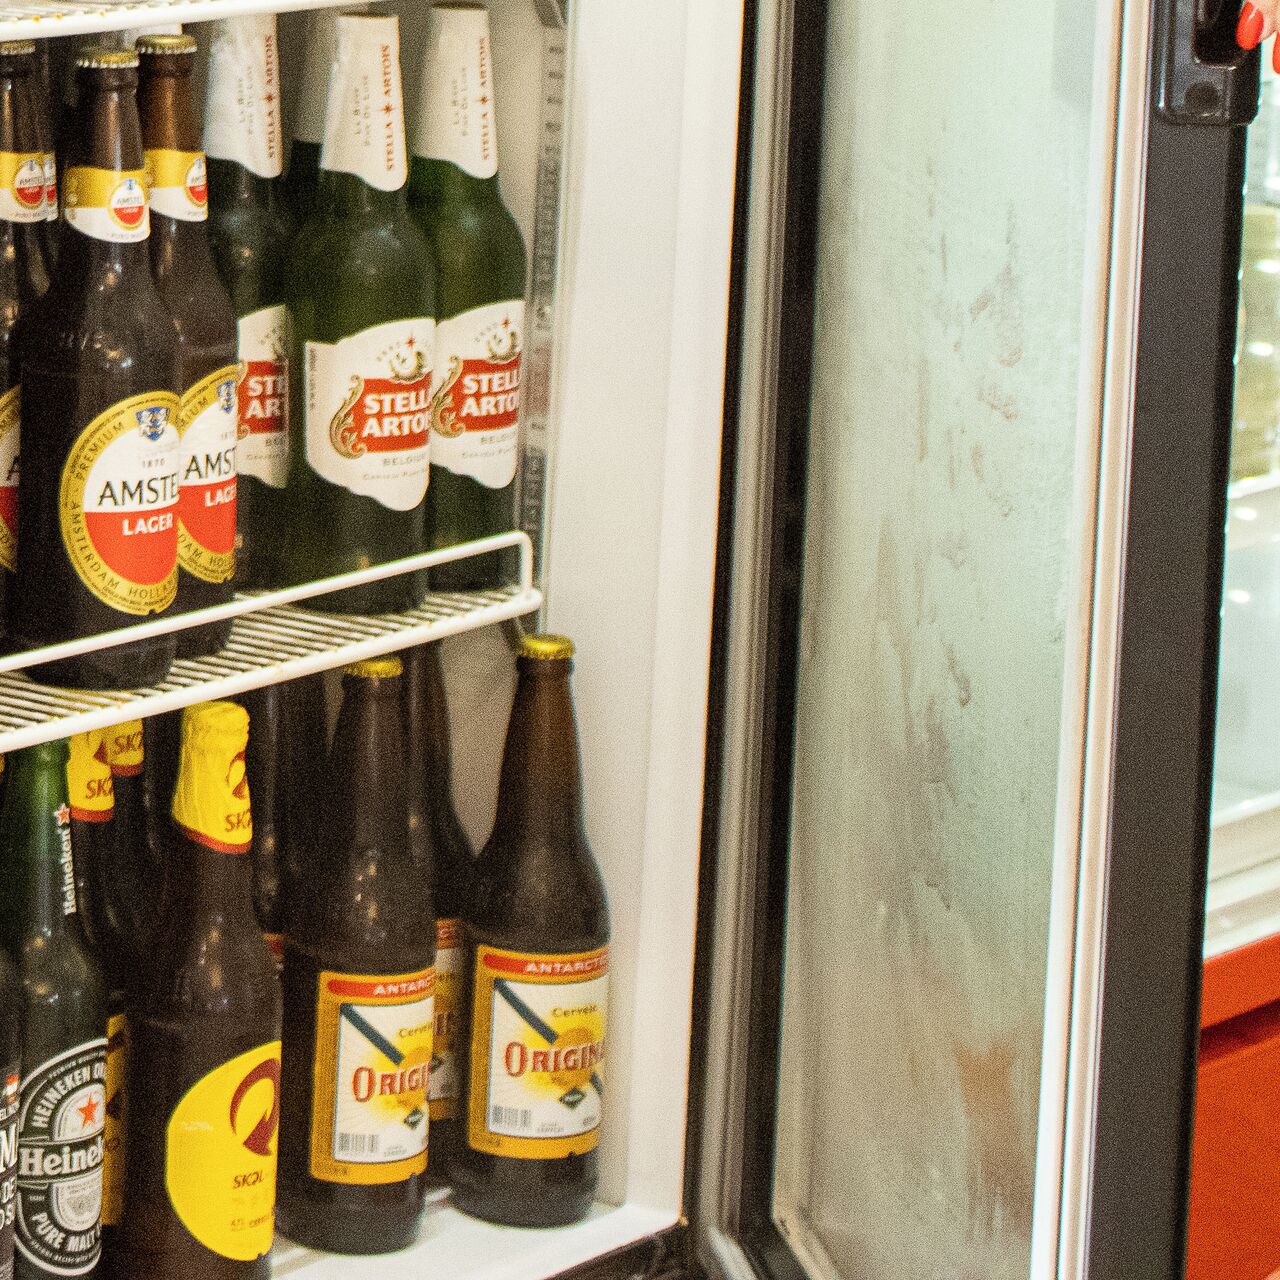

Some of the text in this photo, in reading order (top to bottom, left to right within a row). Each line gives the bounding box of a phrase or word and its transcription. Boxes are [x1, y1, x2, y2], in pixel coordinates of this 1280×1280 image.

[264, 34, 275, 159] STELLA ARTOIS
[381, 43, 394, 172] STELLA ARTOIS
[480, 111, 490, 160] STELLA
[75, 422, 126, 480] PREMIUM
[67, 499, 121, 591] AMSTERDAM
[122, 513, 173, 536] LAGER
[57, 828, 77, 916] Heineken
[32, 1065, 91, 1128] HEINEKEN
[32, 1212, 67, 1250] PURE
